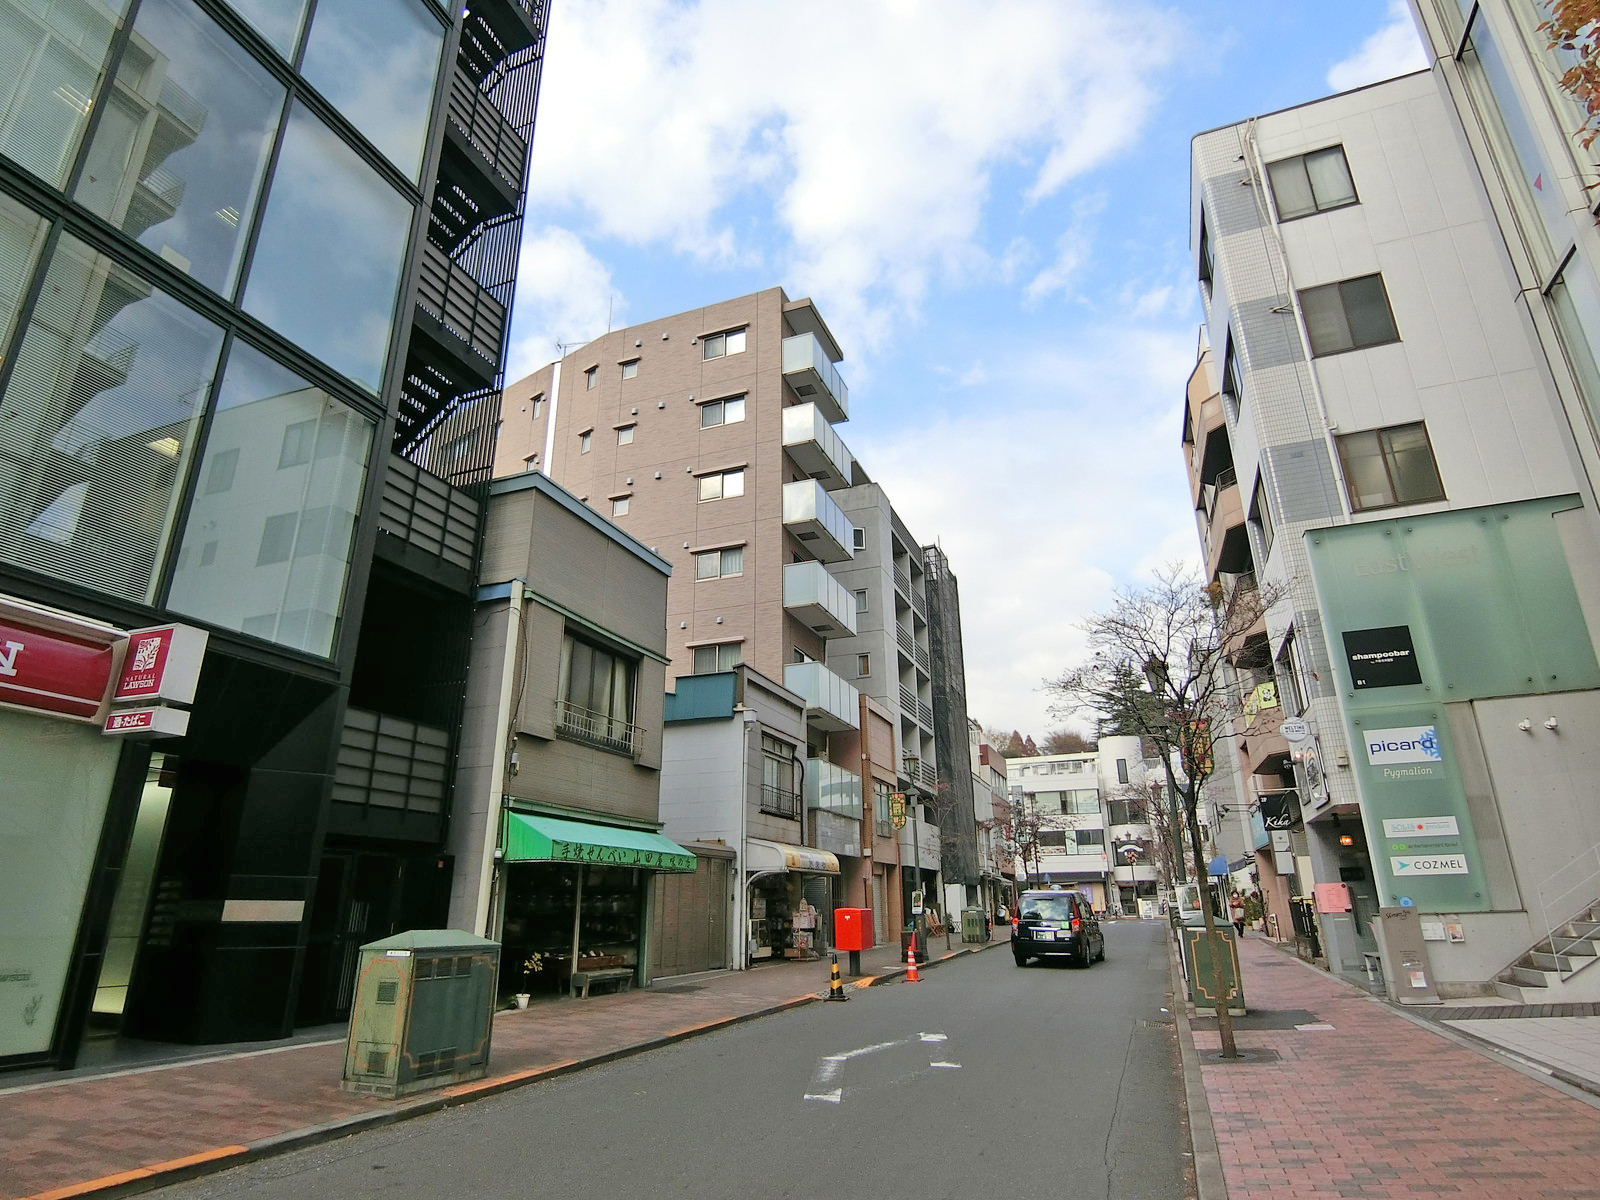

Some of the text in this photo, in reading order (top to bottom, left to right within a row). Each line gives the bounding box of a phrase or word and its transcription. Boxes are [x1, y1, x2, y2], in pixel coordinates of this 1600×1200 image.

[1352, 553, 1409, 577] East
[1352, 650, 1410, 662] shampoobar
[125, 673, 156, 682] NATURAL
[123, 679, 155, 690] LAWSON
[1370, 737, 1434, 755] picard
[1384, 766, 1433, 778] Pygmalion
[1265, 813, 1291, 828] Kika
[1413, 859, 1464, 870] COZMEL
